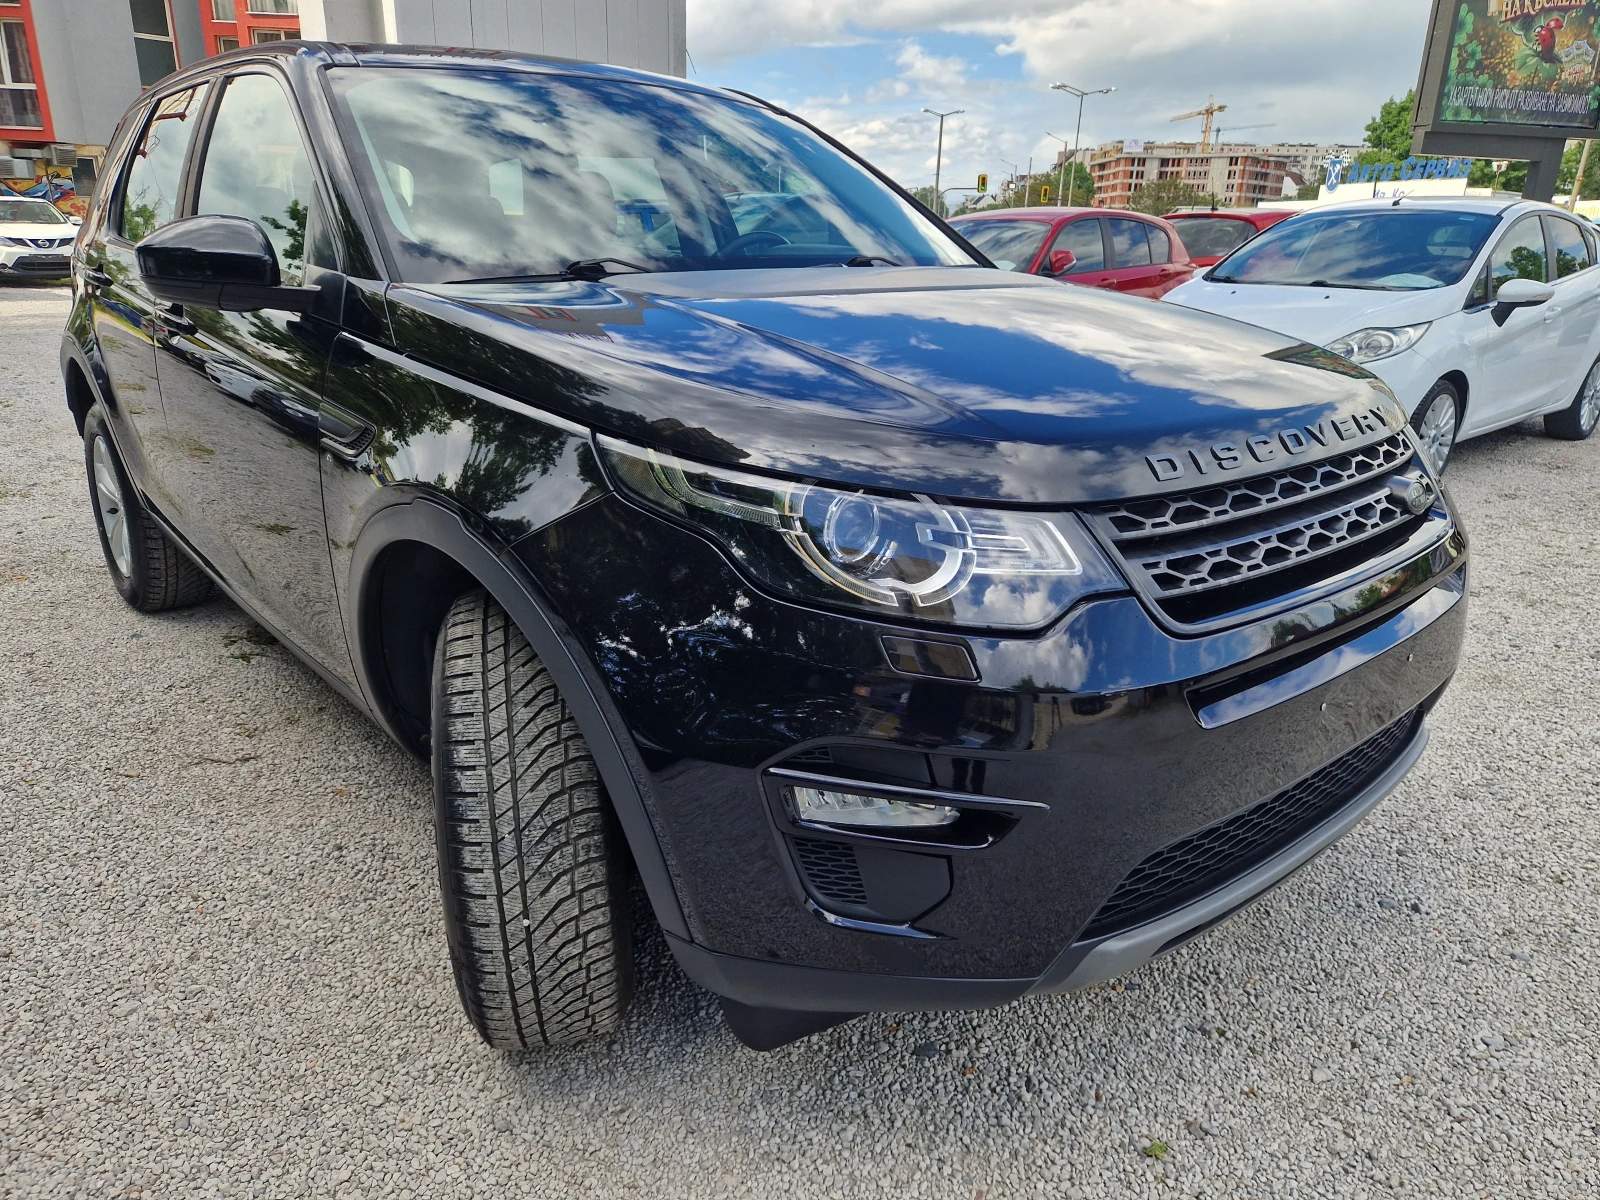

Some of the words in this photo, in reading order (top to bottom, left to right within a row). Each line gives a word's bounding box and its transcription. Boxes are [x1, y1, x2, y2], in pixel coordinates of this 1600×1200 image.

[1449, 86, 1479, 106] ХАЗАРТЪТ
[1508, 89, 1519, 110] ОТ
[1145, 404, 1395, 482] DISCOVERY
